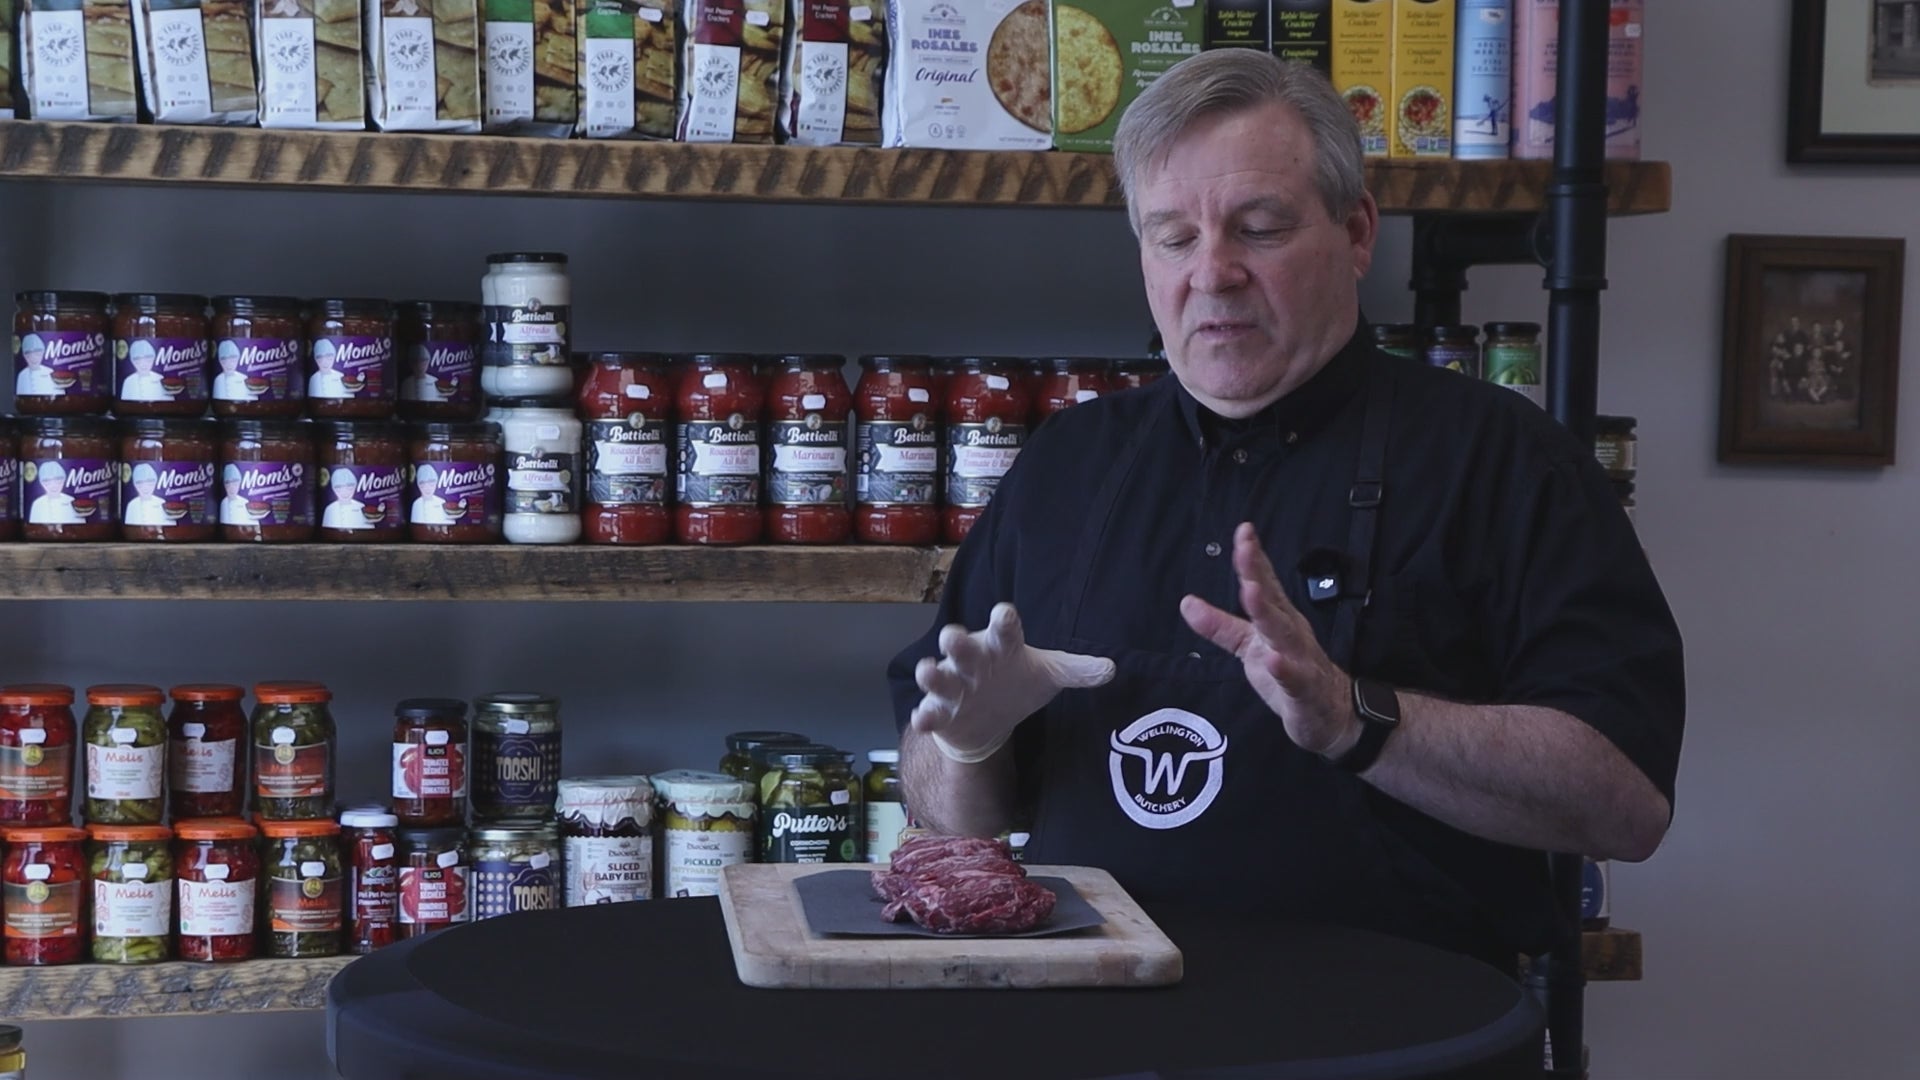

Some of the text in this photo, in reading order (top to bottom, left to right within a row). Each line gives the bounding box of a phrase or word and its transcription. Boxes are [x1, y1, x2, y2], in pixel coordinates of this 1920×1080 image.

[928, 28, 961, 40] INES
[1149, 31, 1183, 42] INES
[911, 39, 979, 53] ROSALES
[1131, 42, 1200, 54] ROSALES
[915, 67, 980, 86] Original
[512, 309, 554, 323] Botticelli
[44, 334, 95, 360] Mom's
[155, 340, 201, 366] Mom's
[240, 341, 288, 366] Mom's
[336, 338, 383, 363] Mom's
[609, 426, 660, 442] Botticelli
[787, 426, 839, 444] Botticelli
[967, 429, 1017, 446] Botticelli
[516, 456, 558, 469] Botticelli
[792, 450, 835, 460] Marinara
[66, 461, 113, 488] Mom's
[157, 464, 207, 490] Mom's
[241, 464, 292, 490] Mom's
[357, 467, 401, 493] Mom's
[438, 464, 486, 489] Mom's
[1137, 725, 1205, 747] WELLINGTON
[105, 751, 144, 764] Melis
[496, 756, 541, 781] TORSHI
[1134, 793, 1187, 813] BUTCHERY
[772, 812, 848, 838] Putter's
[608, 862, 640, 871] SLICED
[684, 858, 722, 867] PICKLED
[594, 872, 622, 881] BABY
[115, 887, 153, 899] Melis
[198, 887, 236, 898] Melis
[513, 885, 554, 911] TORSHI
